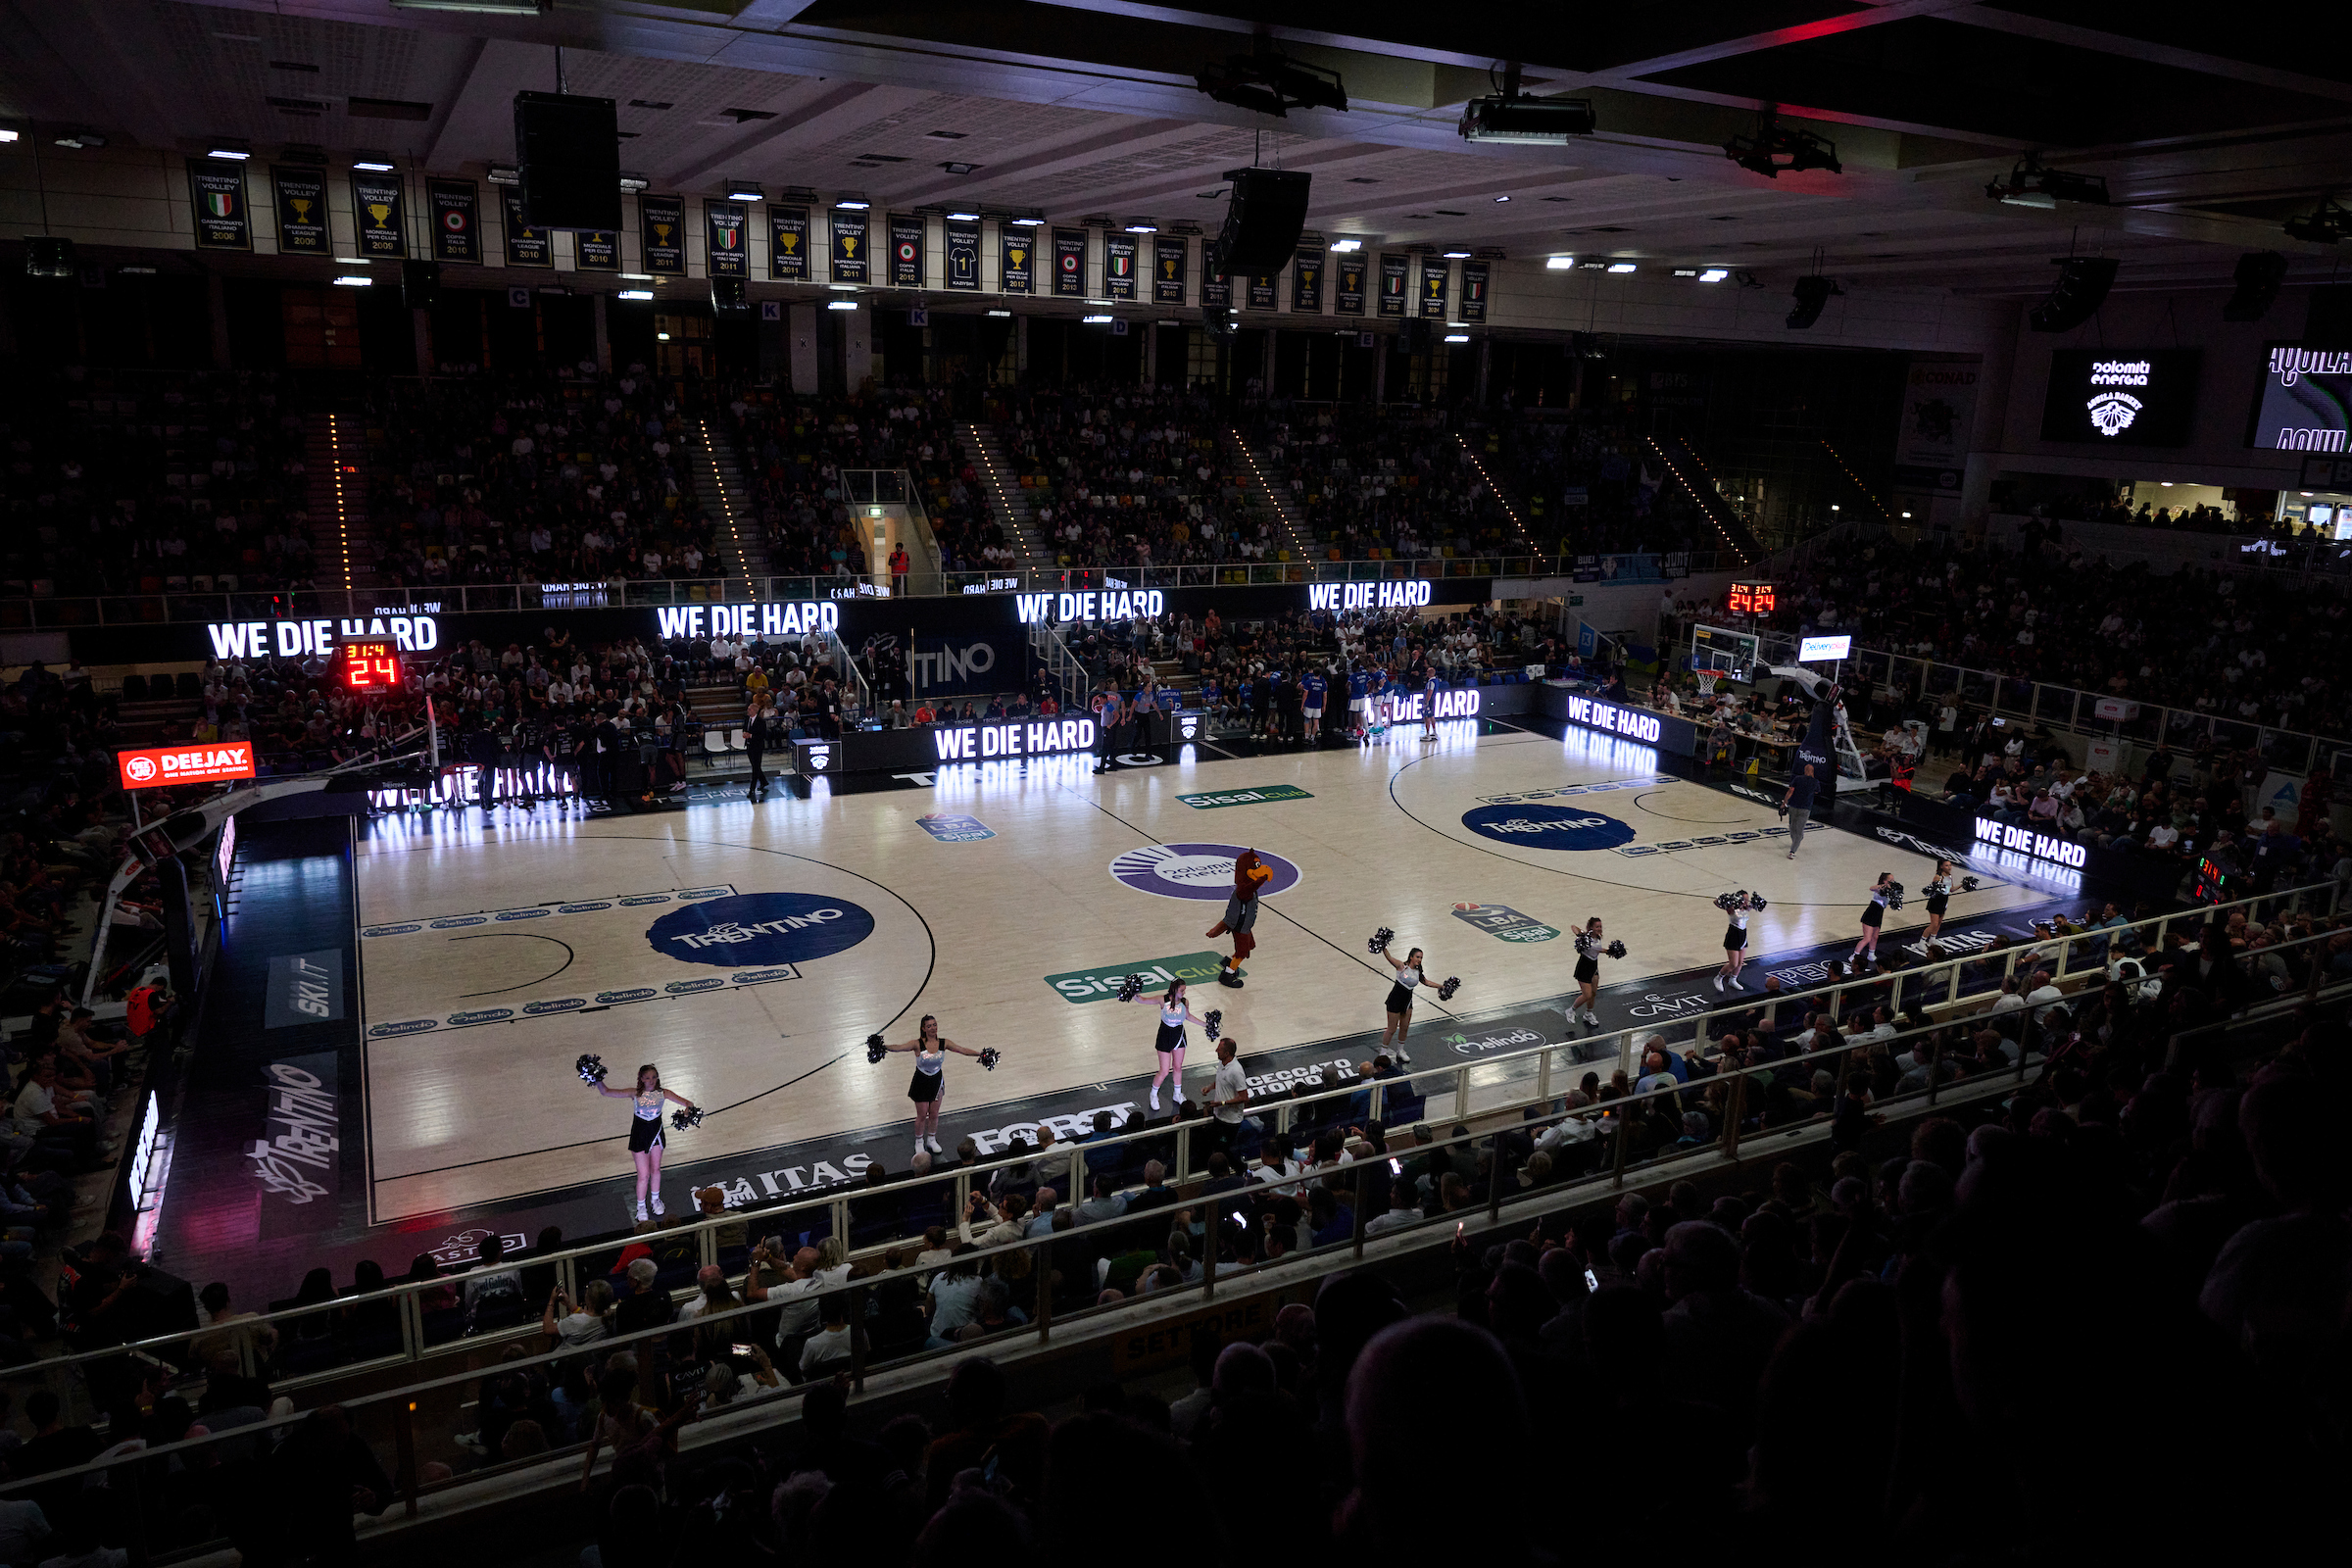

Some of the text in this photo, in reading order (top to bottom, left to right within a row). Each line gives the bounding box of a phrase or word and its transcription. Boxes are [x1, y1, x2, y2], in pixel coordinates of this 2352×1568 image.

[196, 175, 240, 185] TRENTINO
[202, 182, 235, 191] VOLLEY
[278, 181, 320, 191] TRENTINO
[358, 187, 398, 196] TRENTINO
[434, 193, 472, 202] TRENTINO
[201, 219, 244, 227] CAMPIONATO
[284, 223, 323, 232] CHAMPIONS
[773, 218, 805, 226] TRENTINO
[212, 231, 235, 241] 2008
[294, 236, 317, 246] 2009
[372, 241, 394, 250] 2009
[447, 245, 468, 255] 2010
[519, 250, 540, 259] 2010
[589, 255, 609, 264] 2010
[959, 257, 966, 270] 1
[513, 290, 527, 305] C
[764, 304, 777, 318] K
[914, 311, 926, 323] K
[1116, 320, 1126, 333] D
[1925, 371, 1976, 385] CONAD
[2090, 373, 2148, 386] energia
[1308, 580, 1432, 611] WE DIE HARD
[1730, 593, 1776, 612] 24 24
[1016, 589, 1165, 624] WE DIE HARD
[657, 601, 841, 640] WE DIE HARD
[207, 621, 270, 661] WE
[275, 618, 334, 658] DIE
[349, 659, 396, 685] 24
[1568, 695, 1661, 743] WE DIE HARD
[934, 718, 1095, 760] WE DIE HARD
[161, 749, 248, 772] DEEJAY.
[1184, 789, 1307, 808] Sisal Club
[1481, 816, 1607, 834] TRENTINO
[1975, 816, 2004, 844] WE
[2003, 824, 2034, 854] DIE
[2034, 833, 2087, 868] HARD
[1172, 867, 1238, 881] energi
[1474, 914, 1529, 927] LBA
[670, 907, 844, 949] TRENTINO
[1502, 926, 1552, 940] Sisal
[1055, 965, 1176, 998] Sisal
[1629, 994, 1709, 1018] CAVIT
[1454, 1029, 1540, 1054] Melinda
[967, 1101, 1144, 1155] FORST
[756, 1152, 874, 1197] ITAS
[1127, 1303, 1261, 1359] SETTORE
